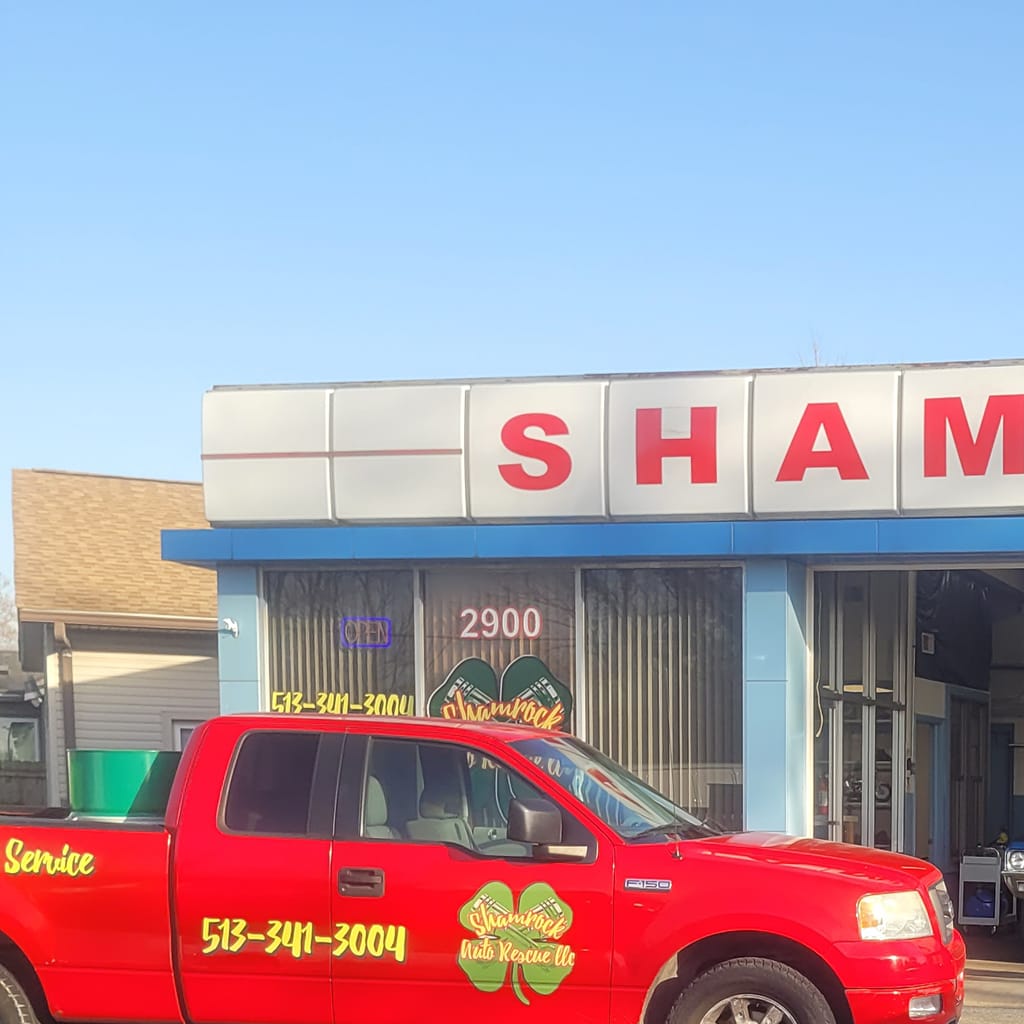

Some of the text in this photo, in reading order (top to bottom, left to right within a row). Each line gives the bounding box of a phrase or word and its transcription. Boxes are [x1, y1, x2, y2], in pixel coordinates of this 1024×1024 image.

[344, 620, 389, 644] OPEN
[460, 606, 543, 639] 2900
[271, 691, 414, 716] 513-341-3004
[4, 837, 95, 876] Service
[468, 903, 568, 940] Shamrock
[202, 917, 406, 962] 513-341-3004
[460, 938, 496, 961] Auto
[498, 940, 551, 964] Rescue
